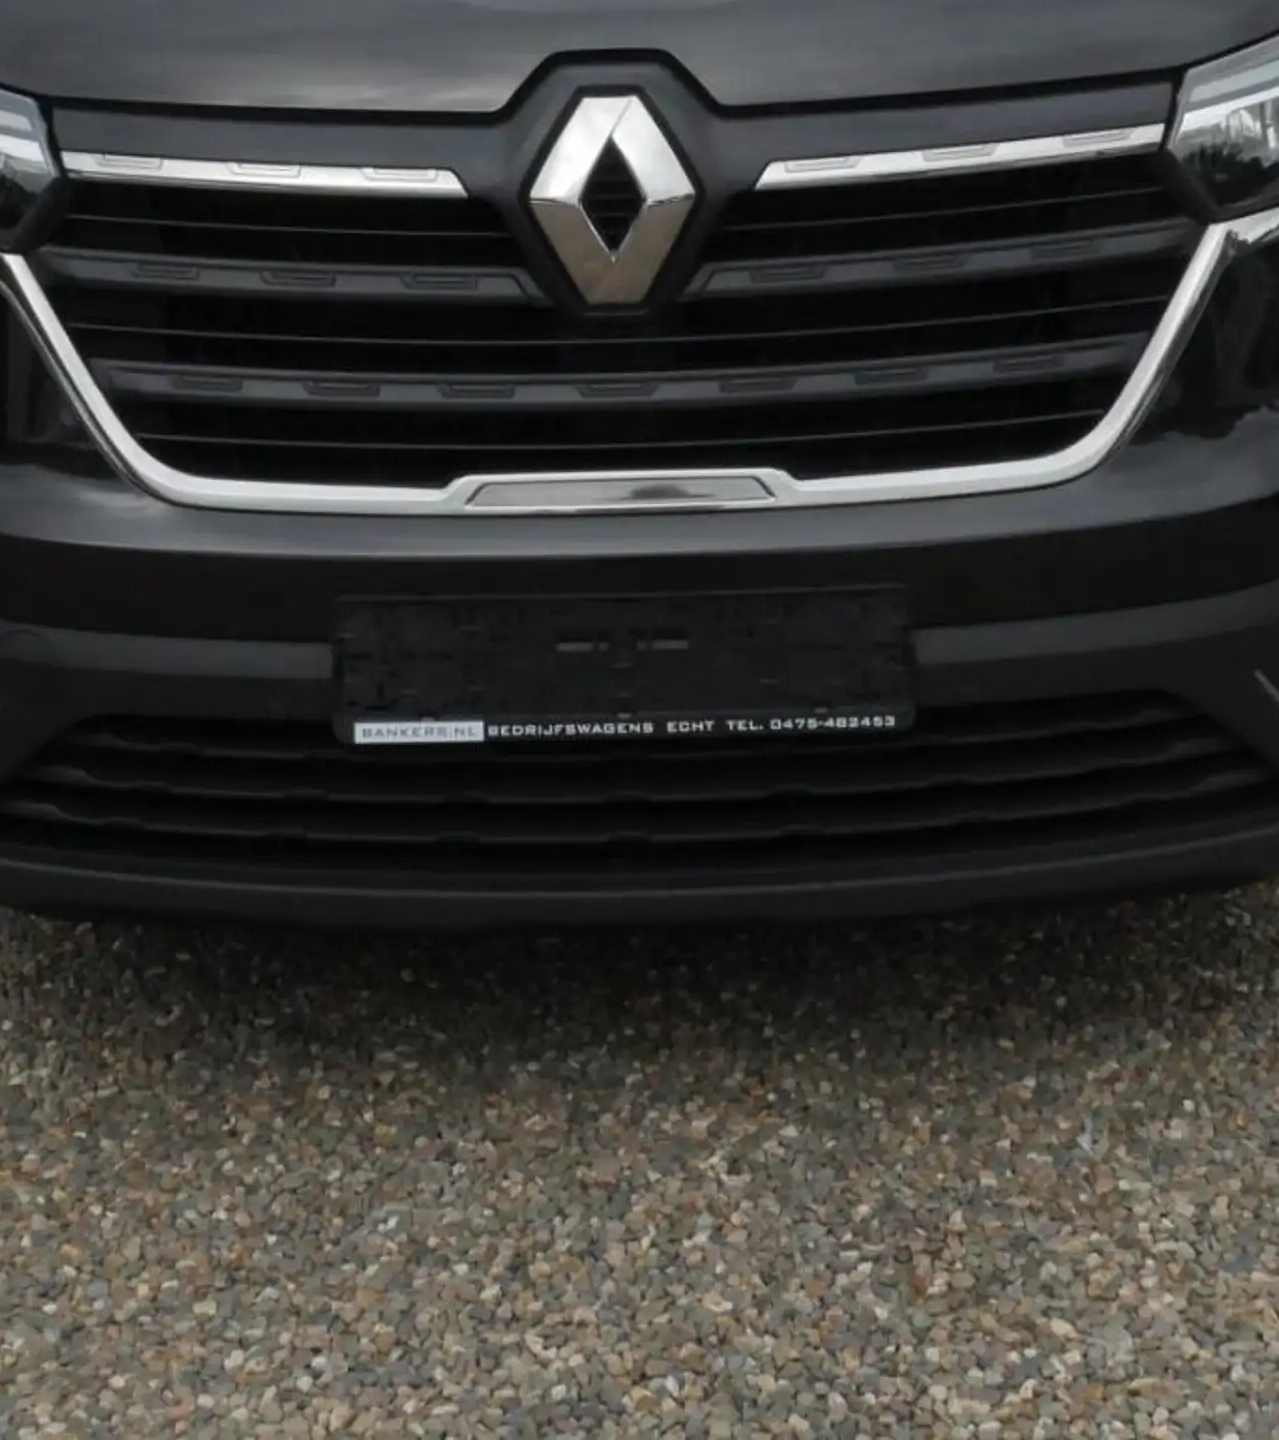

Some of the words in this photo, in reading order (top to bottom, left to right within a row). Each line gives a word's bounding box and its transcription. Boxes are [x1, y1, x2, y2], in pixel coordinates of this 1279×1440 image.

[487, 722, 654, 737] BEDRIJFSWAGENS
[666, 720, 716, 734] ECHT
[726, 719, 764, 732] TEL.
